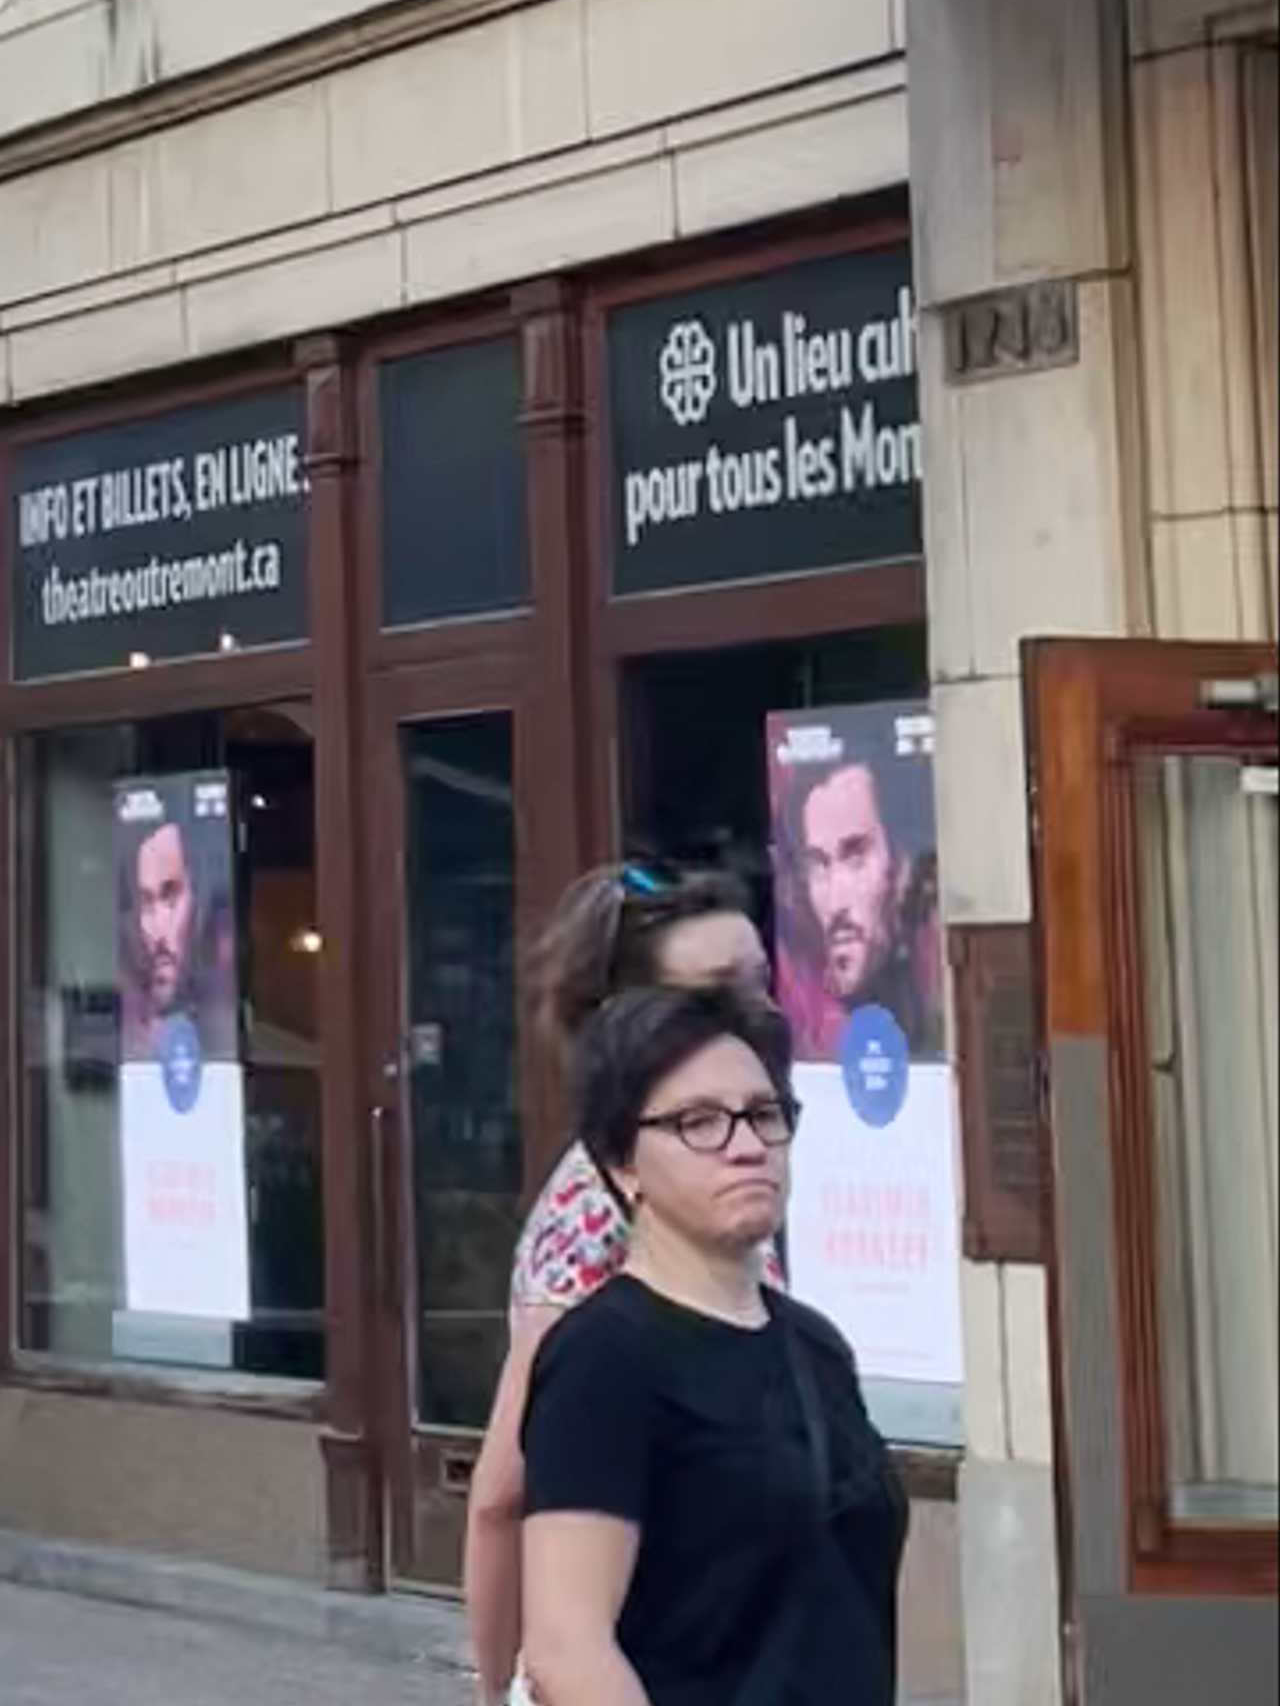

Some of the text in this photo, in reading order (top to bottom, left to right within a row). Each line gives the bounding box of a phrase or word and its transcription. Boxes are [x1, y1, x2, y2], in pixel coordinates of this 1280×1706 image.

[726, 286, 918, 409] Un lieu cul
[18, 481, 69, 548] INFO
[70, 477, 101, 537] ET
[100, 456, 193, 531] BILLETS,
[195, 446, 226, 512] EN
[624, 461, 704, 547] pour
[705, 443, 782, 514] tous
[784, 415, 838, 501] les
[42, 537, 281, 626] theatreoutremont.ca
